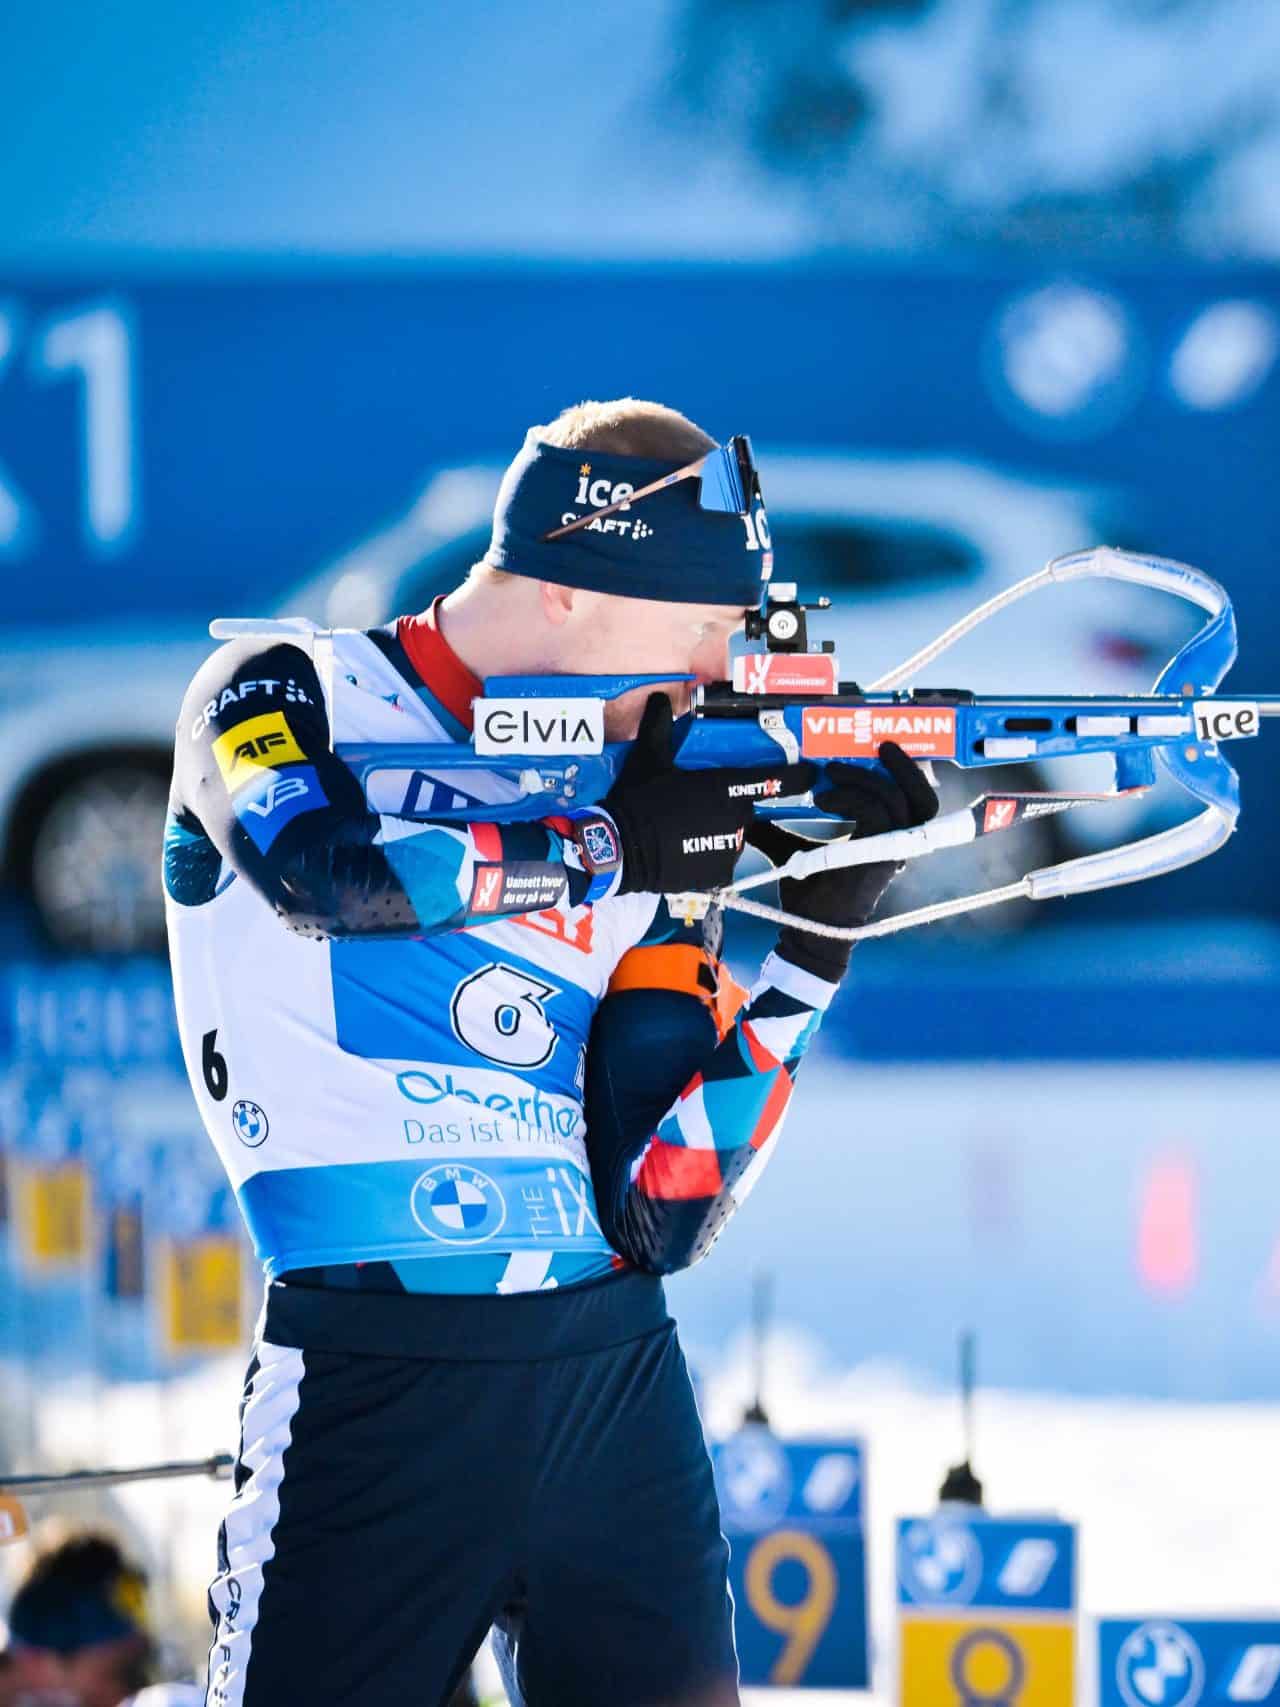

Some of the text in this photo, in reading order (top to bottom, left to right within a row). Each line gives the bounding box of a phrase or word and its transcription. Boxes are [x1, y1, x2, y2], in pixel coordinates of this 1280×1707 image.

[191, 679, 281, 740] CRAFT
[484, 709, 595, 744] Elvia
[1197, 709, 1255, 740] ice
[450, 961, 562, 1071] 6
[202, 1028, 229, 1102] 6
[403, 1119, 461, 1144] Das
[468, 1117, 504, 1144] ist
[521, 1167, 604, 1241] THE iX
[745, 1530, 837, 1686] 9
